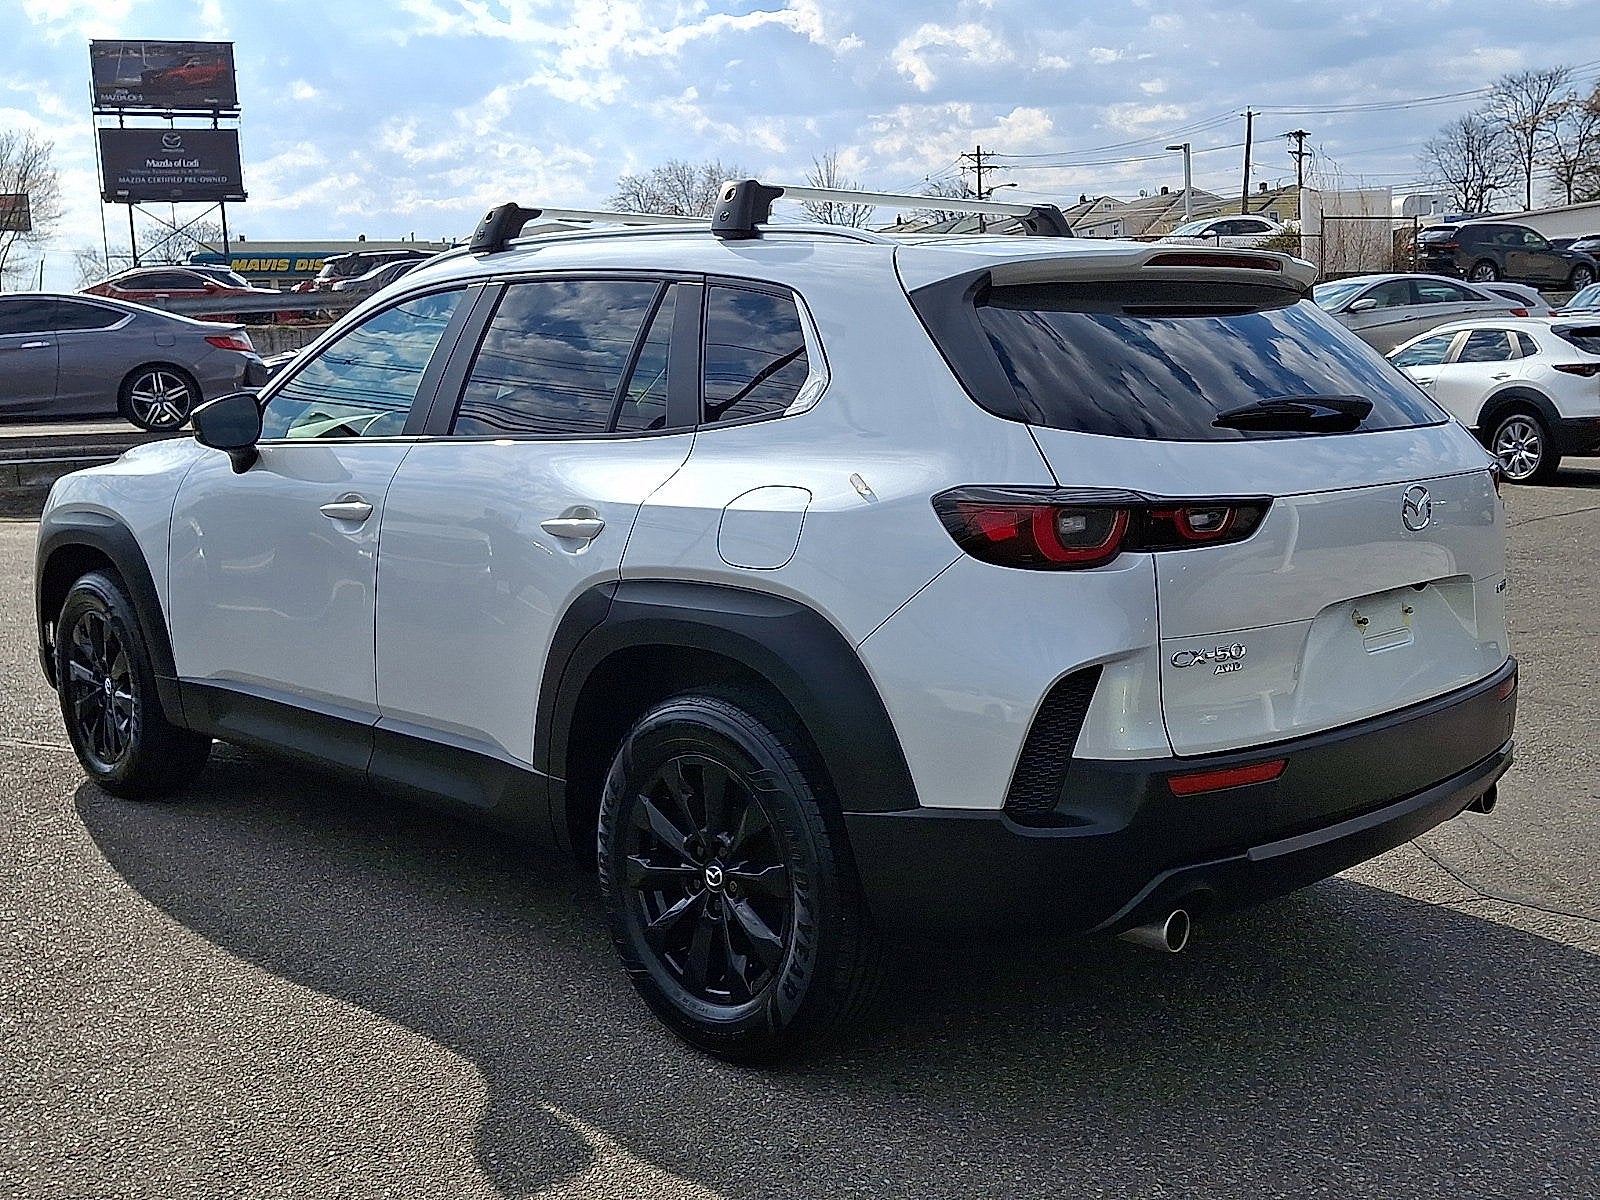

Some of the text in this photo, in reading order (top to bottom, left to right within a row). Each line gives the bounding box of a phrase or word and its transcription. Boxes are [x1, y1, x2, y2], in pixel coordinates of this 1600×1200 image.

[146, 159, 200, 168] Mazda of Lodi
[119, 176, 228, 184] MAZDA CERTIFIED PRE-OWNED
[230, 258, 290, 272] MAVIS
[1171, 642, 1248, 669] CX-50
[1213, 661, 1243, 676] AWD
